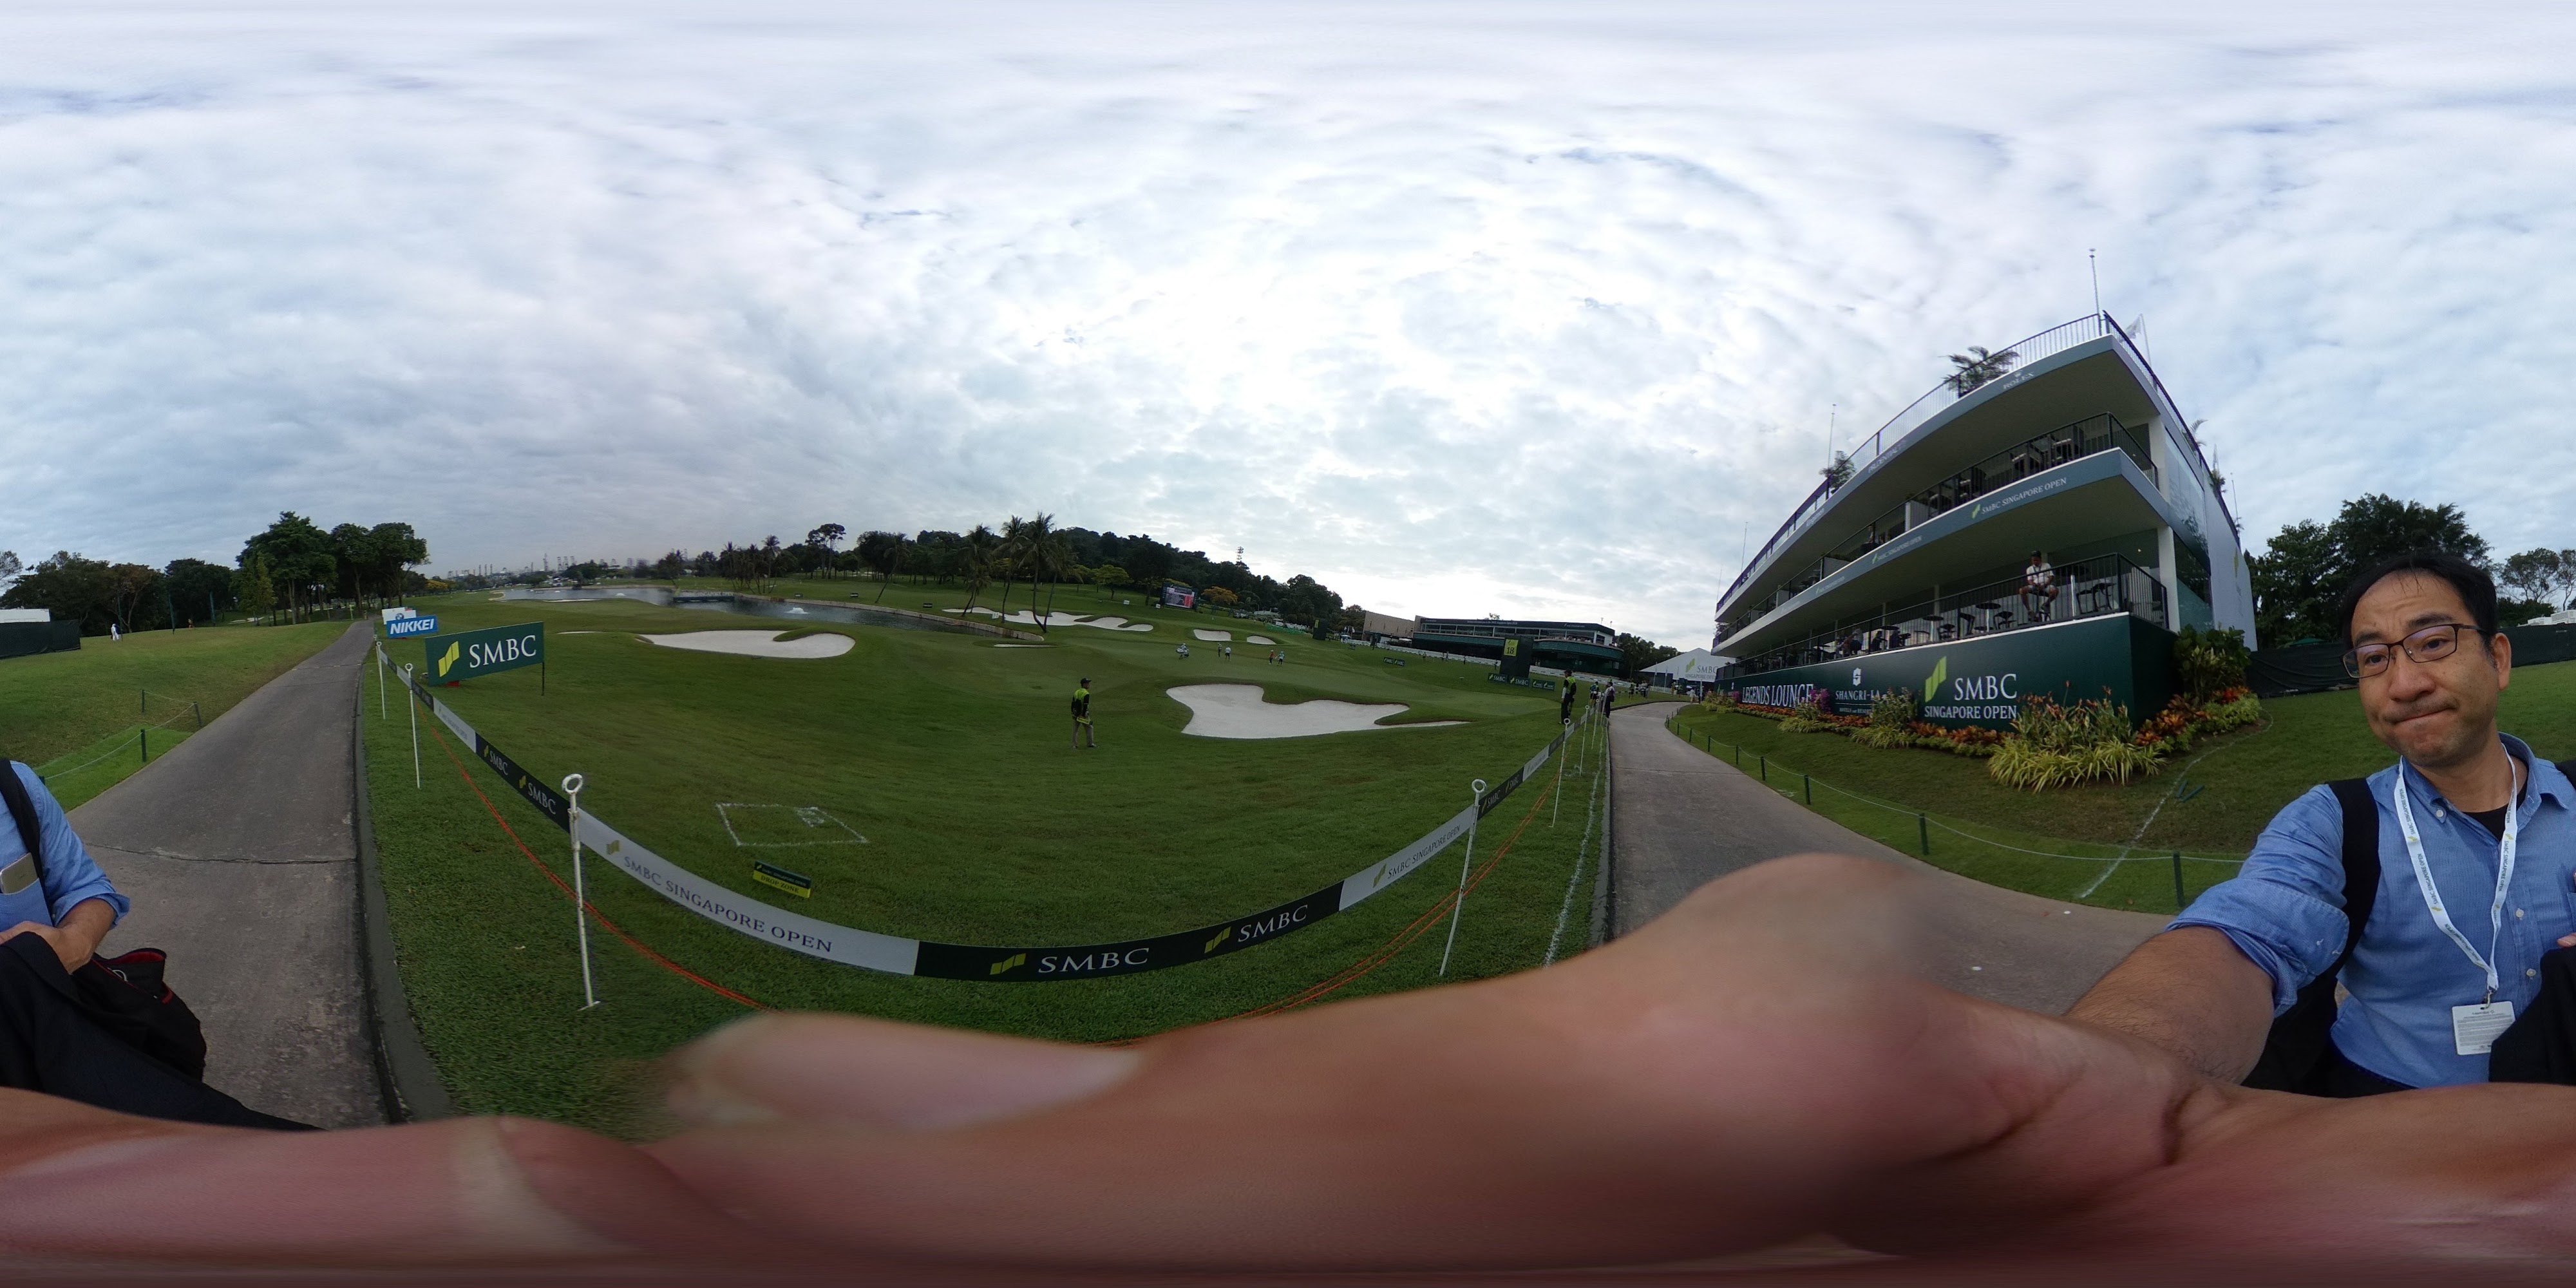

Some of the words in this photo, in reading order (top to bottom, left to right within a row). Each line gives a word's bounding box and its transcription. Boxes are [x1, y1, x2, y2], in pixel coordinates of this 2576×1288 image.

[2003, 371, 2034, 390] ROLEX
[1982, 500, 2000, 515] SMBC
[2002, 484, 2044, 509] SINGAPORE
[2045, 477, 2067, 491] OPEN
[390, 618, 435, 634] NIKKEI
[469, 635, 536, 668] SMBC
[1697, 665, 1718, 674] SMBC
[1742, 685, 1770, 705] LEGENDS
[1835, 690, 1880, 700] SHANGRI-LA
[1955, 674, 2017, 701] SMBC
[1924, 706, 1981, 719] SINGAPORE
[1984, 705, 2017, 719] OPEN
[489, 750, 507, 775] SMBC
[528, 782, 556, 815] SMBC
[1487, 790, 1501, 808] SMBC
[2401, 799, 2412, 822] SINGAPORE
[1387, 858, 1411, 879] SMBC
[1412, 837, 1446, 864] SINGAPORE
[1446, 824, 1461, 840] OPEN
[2417, 853, 2425, 866] OPEN
[761, 875, 779, 886] DROP
[780, 882, 799, 893] ZONE
[2421, 866, 2434, 891] SINGAPORE
[624, 856, 661, 886] SMBC
[666, 880, 764, 933] SINGAPORE
[772, 926, 832, 953] OPEN
[2430, 891, 2439, 905] SMBC
[1238, 905, 1309, 943] SMBC
[1037, 947, 1150, 974] SMBC
